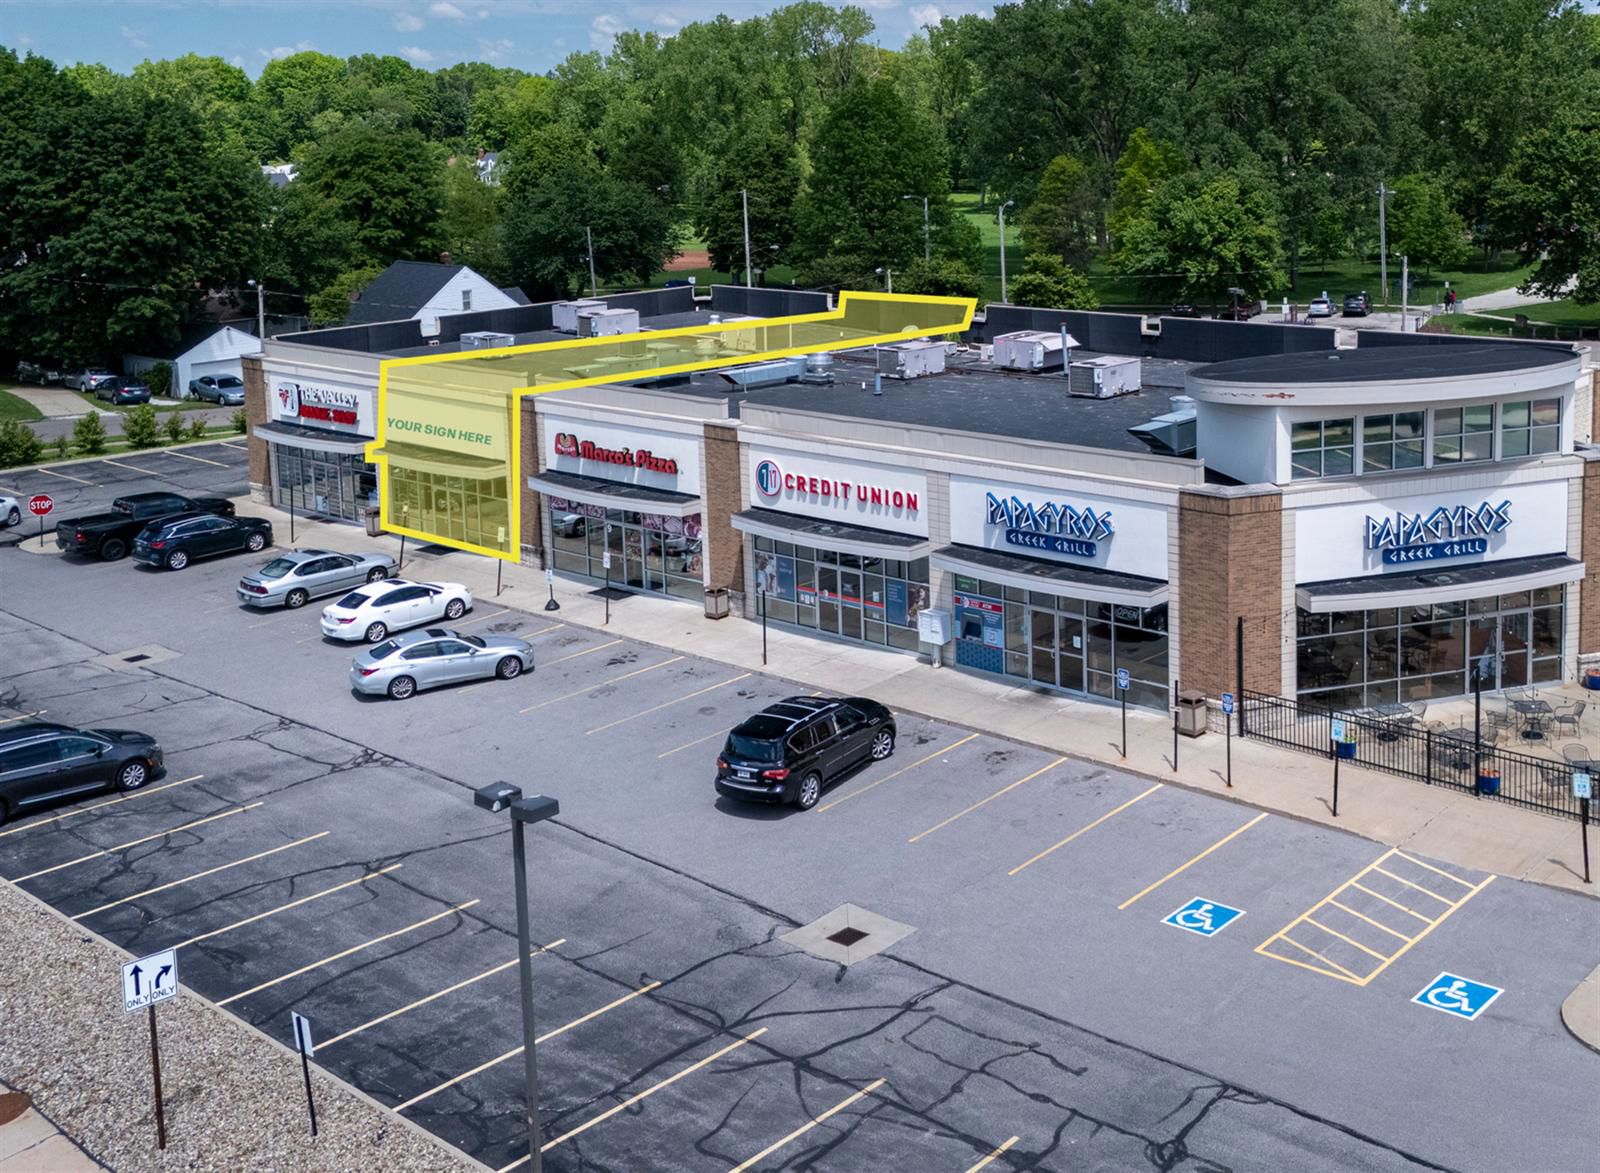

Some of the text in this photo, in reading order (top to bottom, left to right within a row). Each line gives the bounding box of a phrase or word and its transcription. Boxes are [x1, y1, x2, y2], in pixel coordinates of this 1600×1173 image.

[580, 440, 678, 474] Marco's Pizza
[30, 500, 52, 511] STOP
[784, 473, 851, 499] CREDIT
[856, 485, 919, 511] UNION
[986, 492, 1113, 541] PAPAGYROS
[1366, 499, 1512, 549] PAPAGYROS
[1009, 532, 1089, 556] GREEK GRILL
[1390, 540, 1483, 562] GREEK GRILL
[126, 985, 175, 1009] ONLY ONLY
